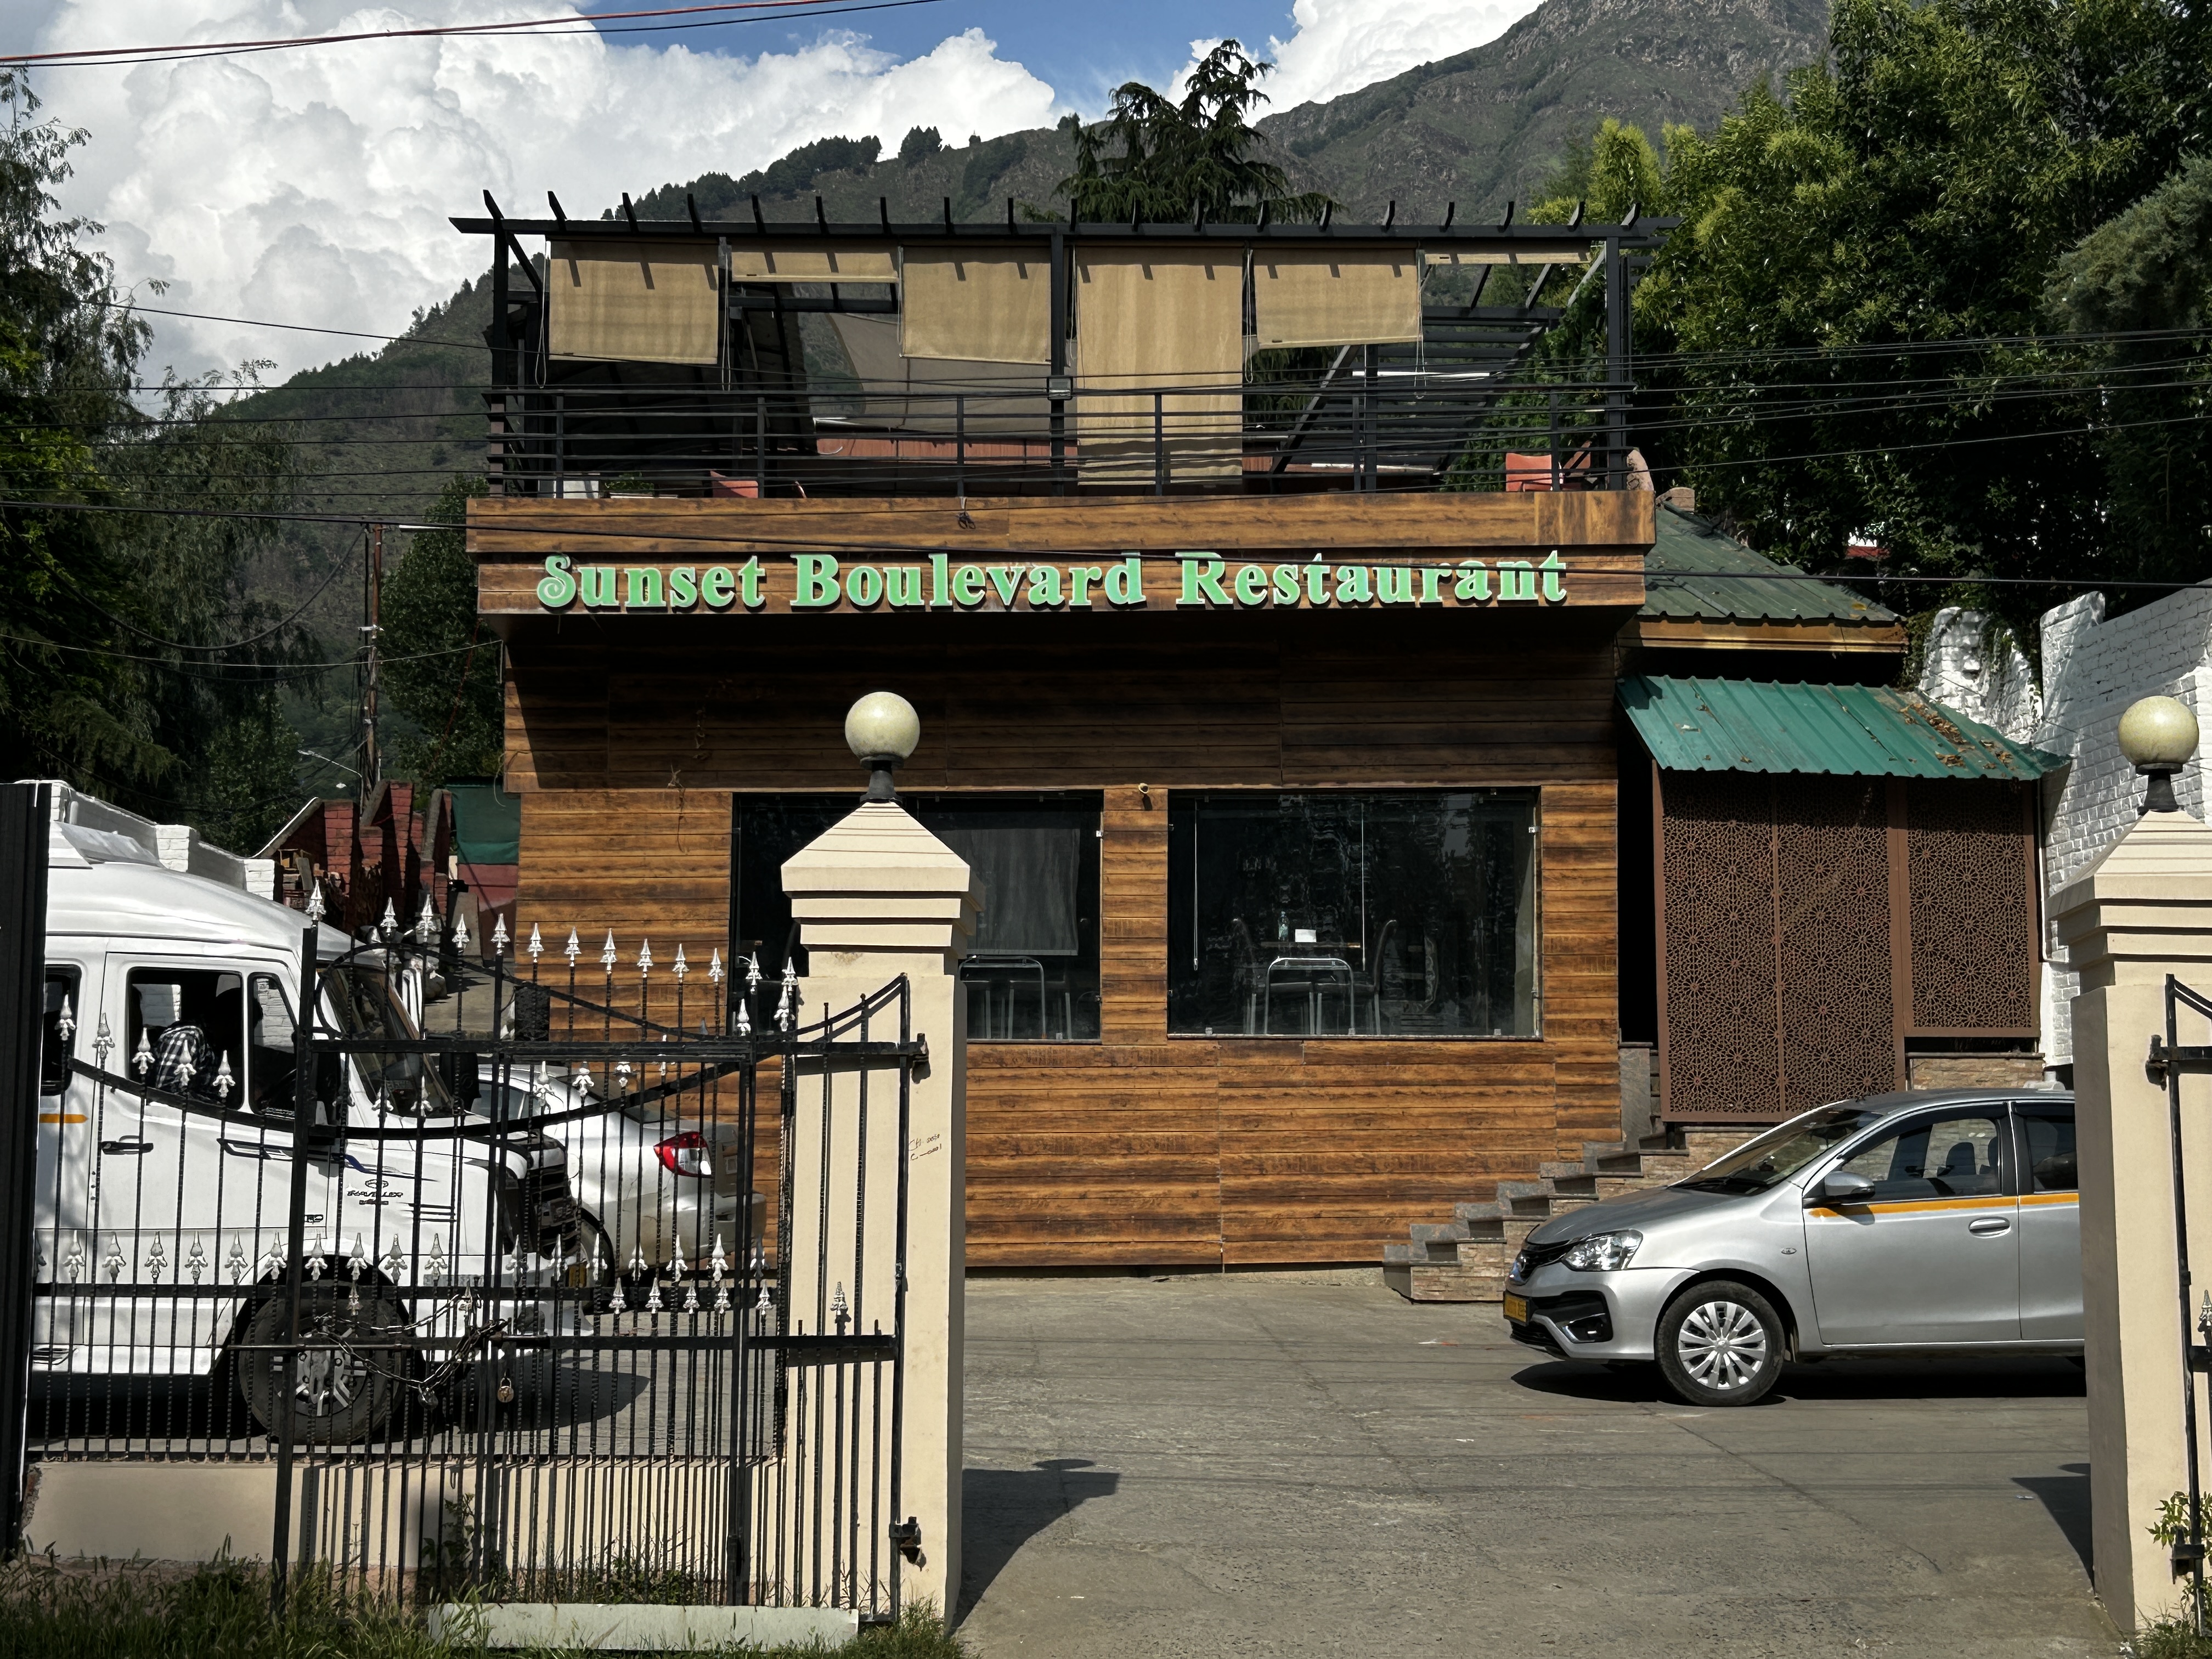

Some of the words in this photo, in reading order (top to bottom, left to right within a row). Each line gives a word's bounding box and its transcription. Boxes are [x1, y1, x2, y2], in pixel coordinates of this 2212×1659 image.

[537, 553, 766, 608] Sunset
[790, 551, 1147, 607] Boulevard
[1175, 550, 1566, 606] Restaurant
[347, 1190, 404, 1198] TRAVELER
